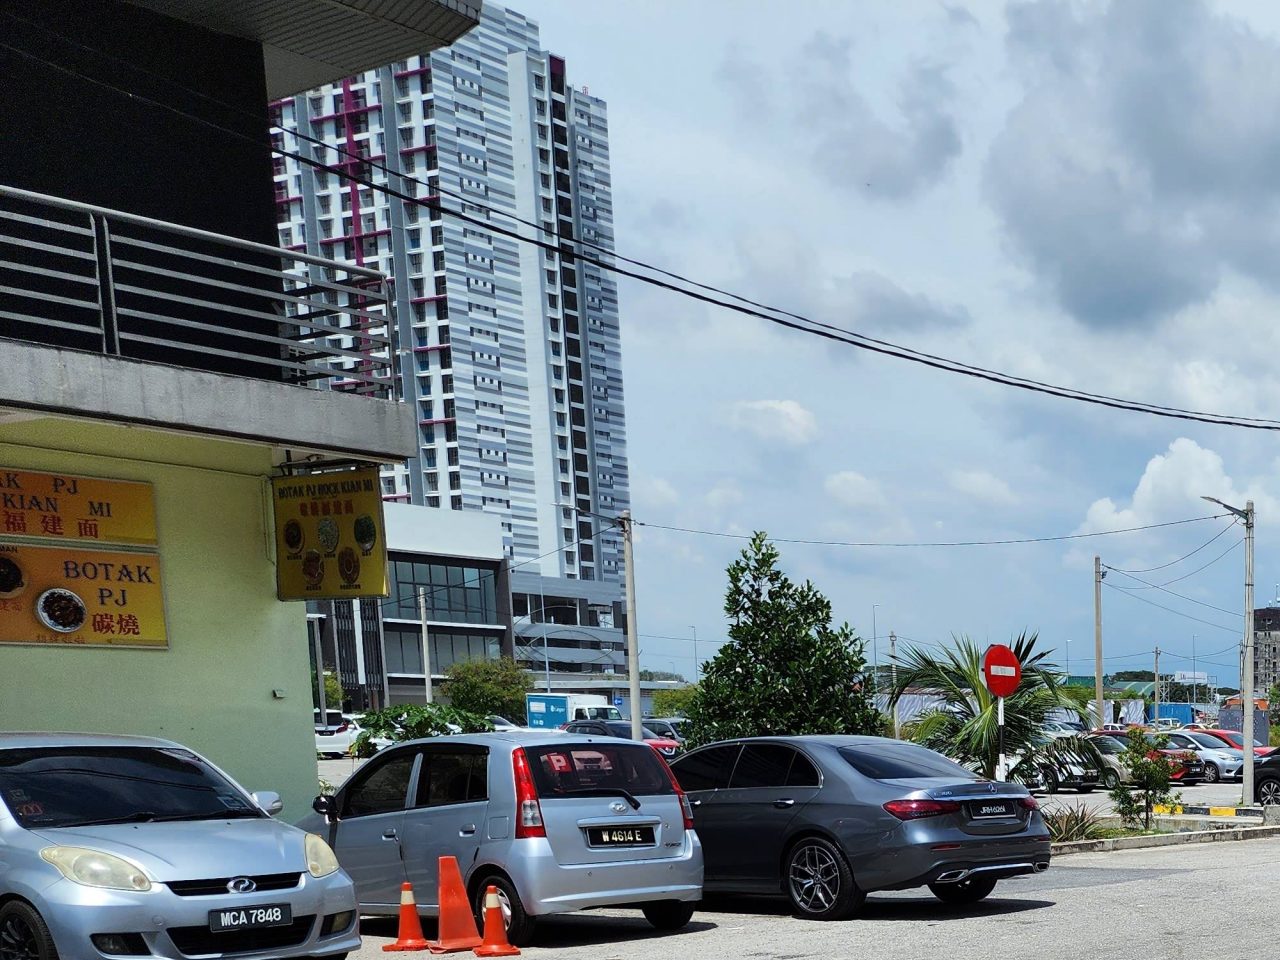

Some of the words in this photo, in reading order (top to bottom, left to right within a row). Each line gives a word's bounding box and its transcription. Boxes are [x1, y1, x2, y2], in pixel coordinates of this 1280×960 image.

[53, 477, 79, 495] PJ
[278, 485, 304, 499] BOTAK
[306, 484, 316, 497] PJ
[341, 480, 362, 494] KIAN
[2, 493, 58, 512] KIAN
[88, 501, 112, 518] MI
[64, 560, 154, 584] BOTAK
[98, 588, 128, 607] PJ
[92, 613, 140, 636] 碳燒
[549, 755, 567, 771] P
[601, 830, 610, 842] W
[611, 830, 634, 842] 4614
[635, 830, 642, 841] E
[220, 910, 248, 927] MCA
[249, 907, 282, 924] 7848
